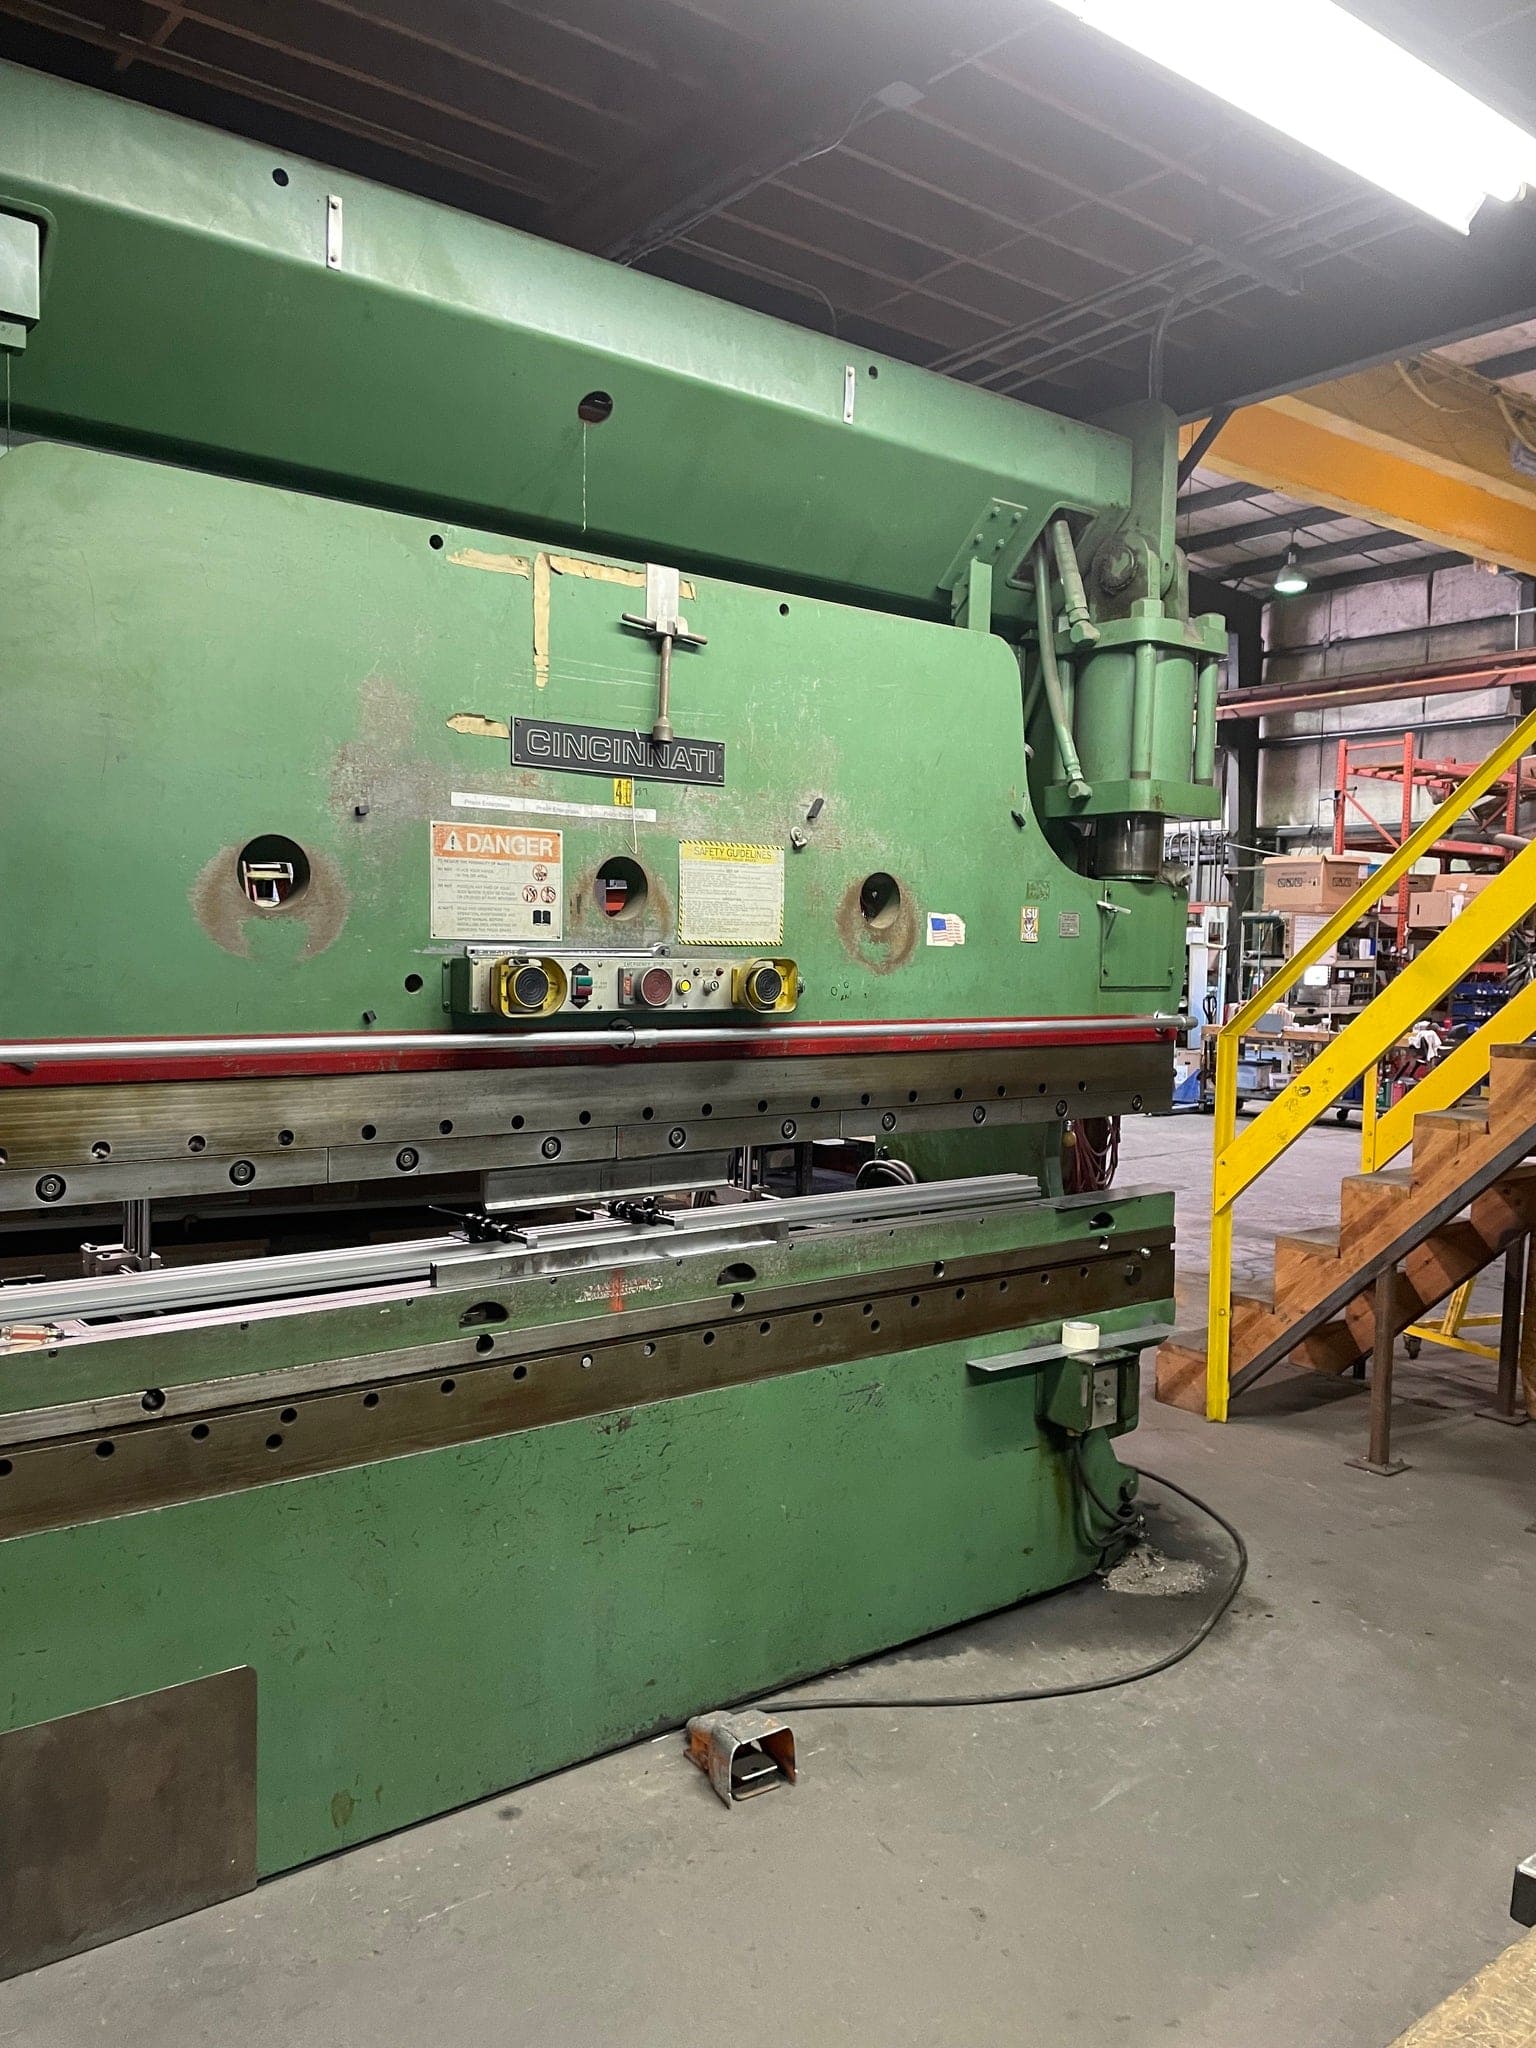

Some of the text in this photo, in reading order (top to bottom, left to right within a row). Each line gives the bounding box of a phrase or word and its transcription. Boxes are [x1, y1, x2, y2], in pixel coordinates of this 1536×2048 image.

[526, 728, 716, 774] CINCINNATI
[466, 831, 553, 857] DANGER
[693, 846, 725, 857] SAFETY
[726, 848, 772, 860] GUIDELINES
[1022, 907, 1038, 919] LSU
